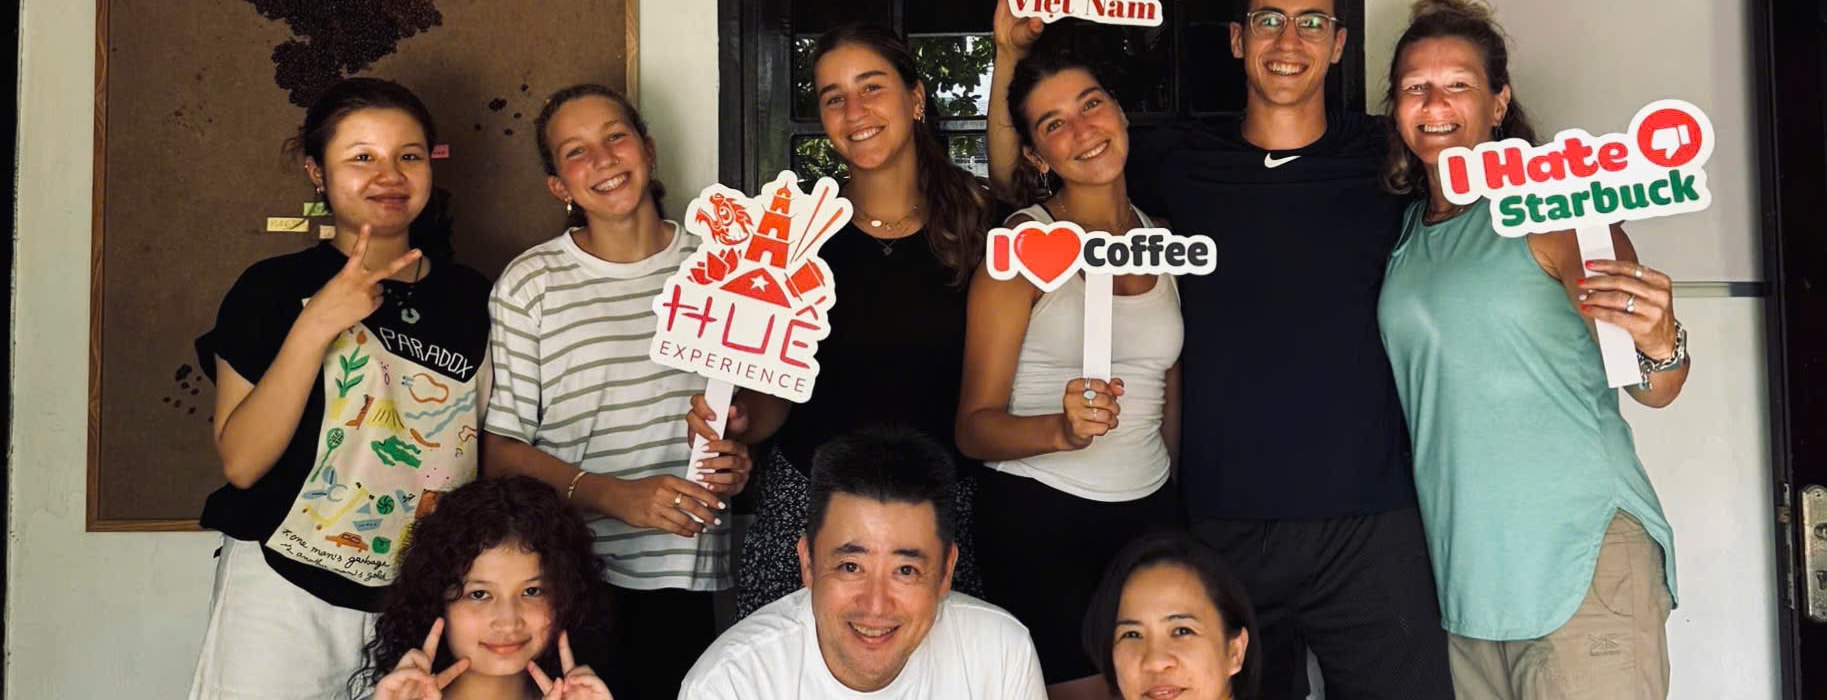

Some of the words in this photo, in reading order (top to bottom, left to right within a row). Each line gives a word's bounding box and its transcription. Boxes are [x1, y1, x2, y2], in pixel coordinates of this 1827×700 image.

[1086, 0, 1156, 20] Nam
[1447, 155, 1470, 195] I
[1482, 137, 1628, 189] Hate
[1499, 169, 1700, 227] Starbuck
[993, 234, 1010, 272] I
[1083, 234, 1209, 267] Coffee
[379, 327, 474, 379] PARADOX
[659, 340, 806, 393] EXPERIENCE
[310, 545, 343, 562] man's
[344, 555, 391, 569] garbage
[363, 569, 389, 581] gold
